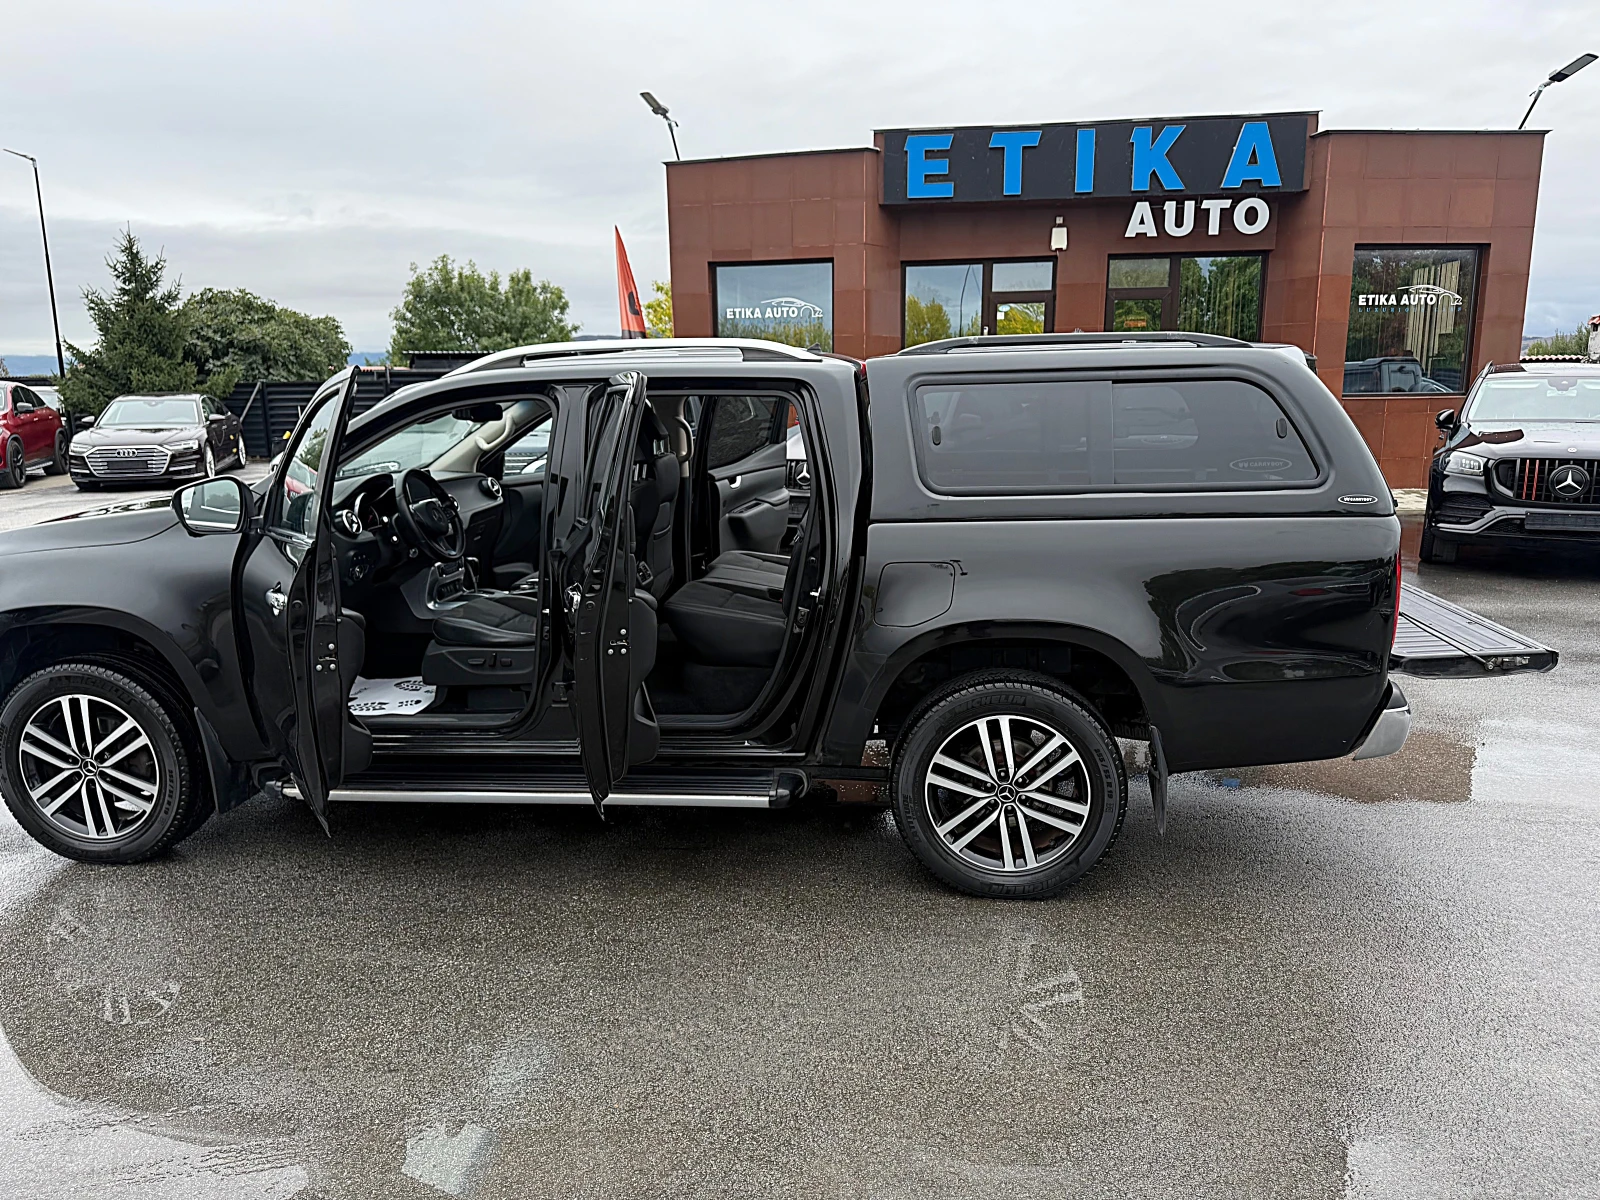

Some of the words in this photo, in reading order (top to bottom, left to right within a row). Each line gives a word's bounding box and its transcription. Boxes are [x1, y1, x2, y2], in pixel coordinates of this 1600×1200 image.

[904, 121, 1282, 199] ETIKA
[1124, 197, 1271, 239] AUTO
[1358, 294, 1397, 306] ETIKA
[1400, 293, 1436, 306] AUTO
[726, 308, 762, 319] ETIKA
[764, 307, 798, 318] AUTO
[954, 694, 1027, 714] MICHELIN
